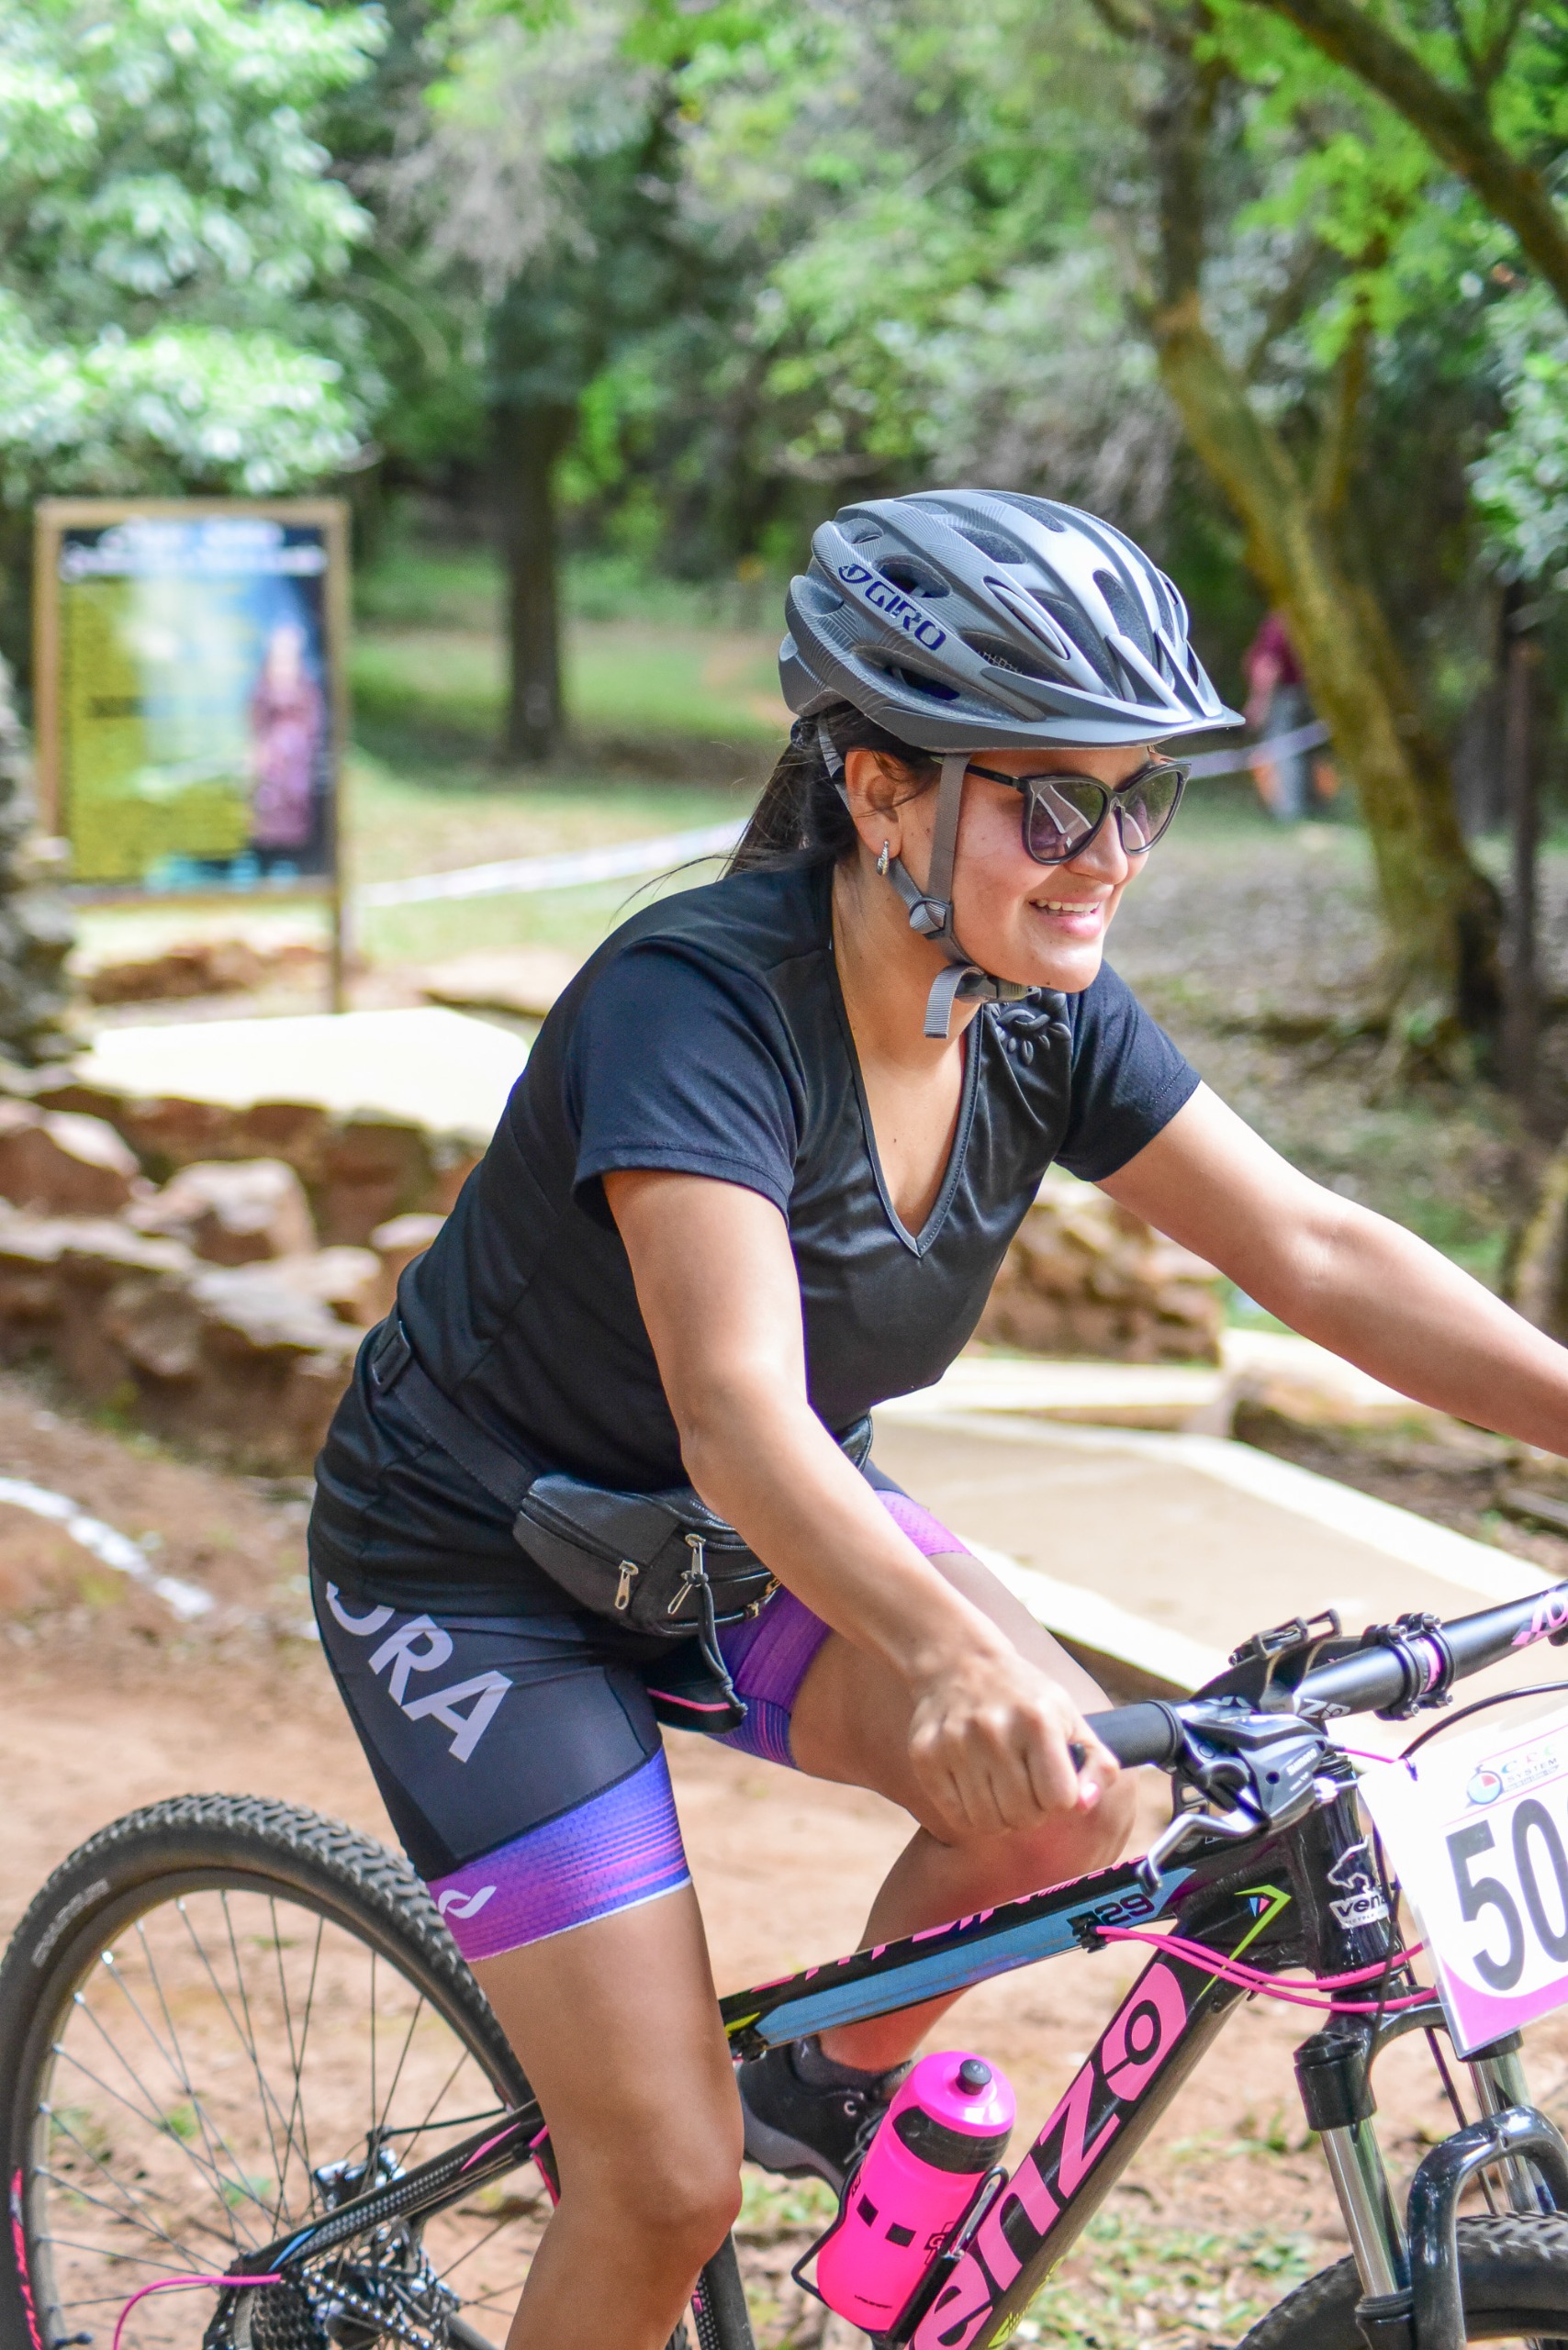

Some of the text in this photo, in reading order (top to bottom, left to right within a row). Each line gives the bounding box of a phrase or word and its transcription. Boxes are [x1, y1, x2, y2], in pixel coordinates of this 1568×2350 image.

[865, 580, 946, 651] GIRO
[1094, 1893, 1155, 1924] 29
[1445, 1798, 1568, 1991] 50
